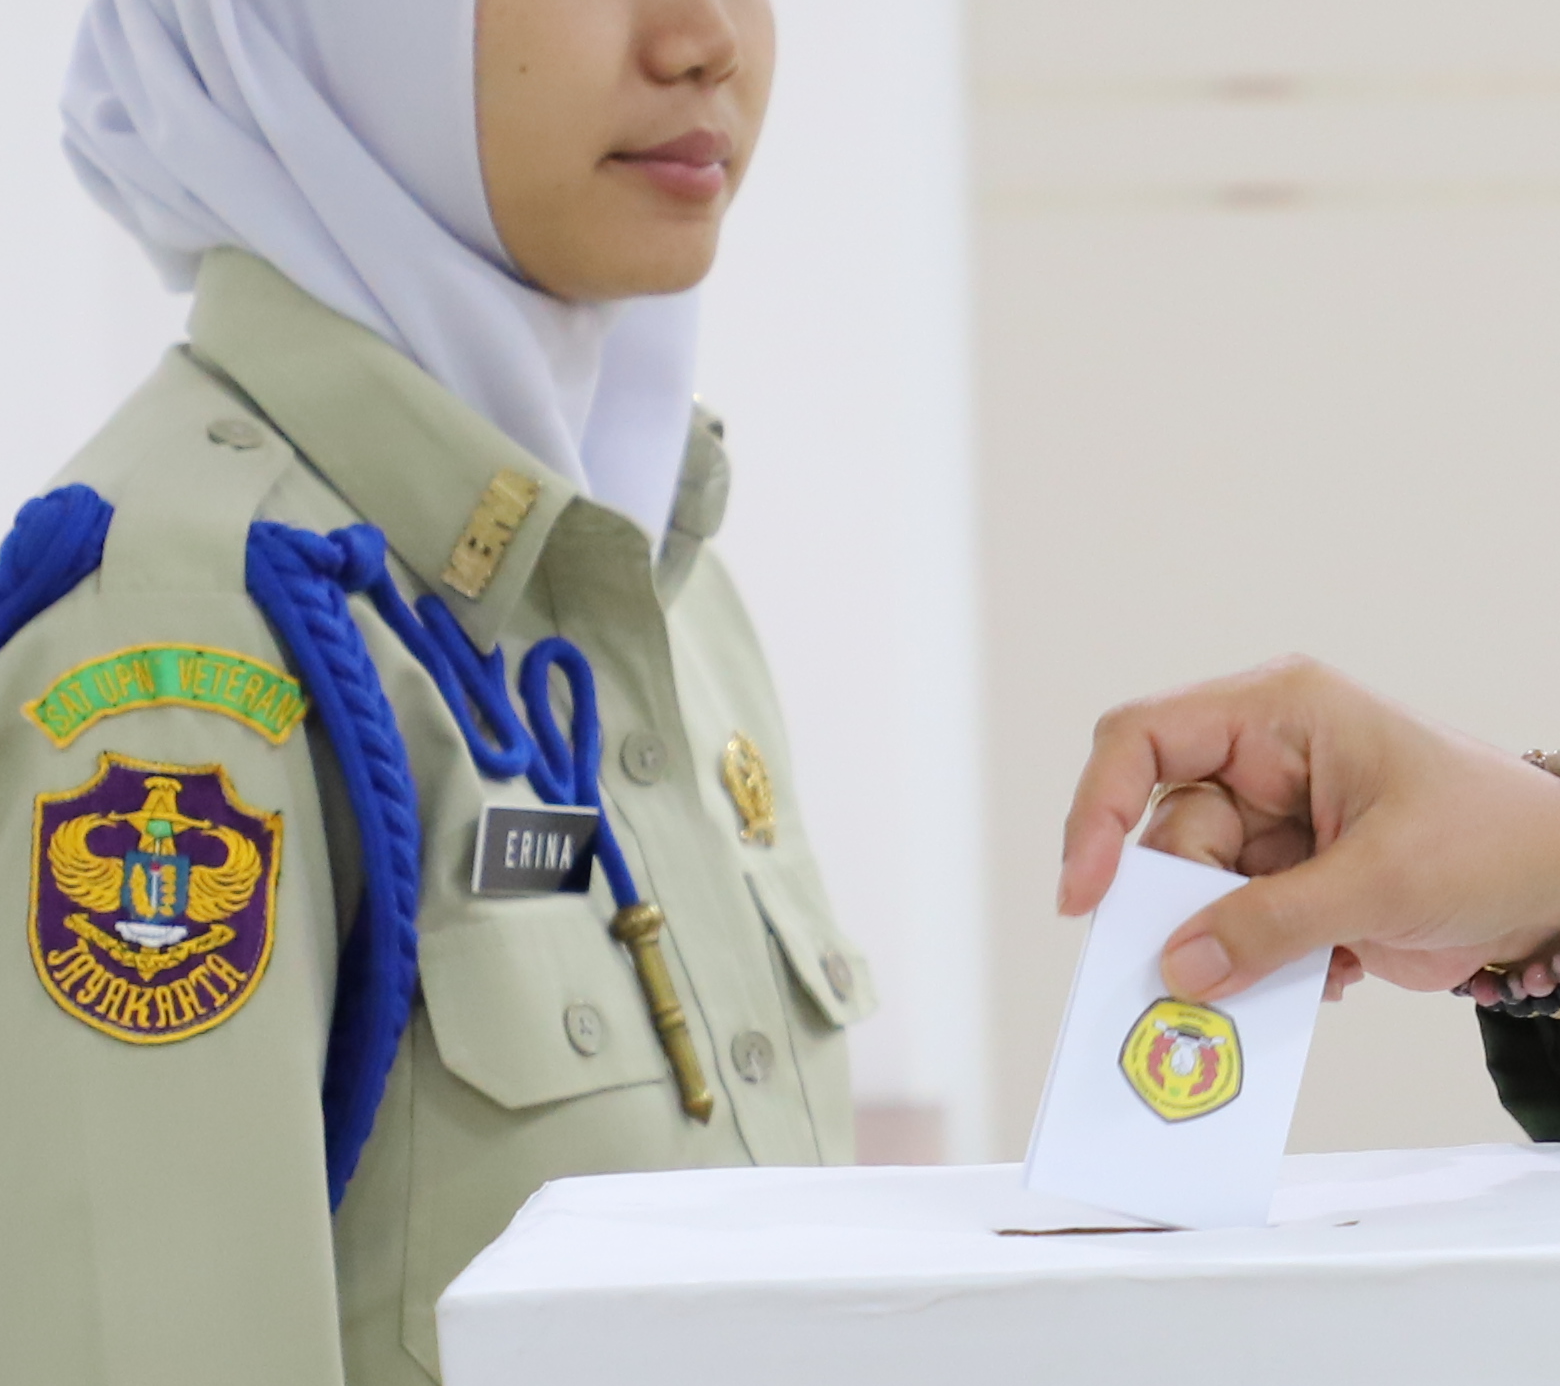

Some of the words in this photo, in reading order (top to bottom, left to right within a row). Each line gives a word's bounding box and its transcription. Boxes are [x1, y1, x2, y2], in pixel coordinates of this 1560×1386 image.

[46, 680, 93, 732] SAT
[93, 658, 155, 704] UPN
[504, 829, 573, 870] ERINA
[47, 936, 248, 1028] JAYAKARTA
